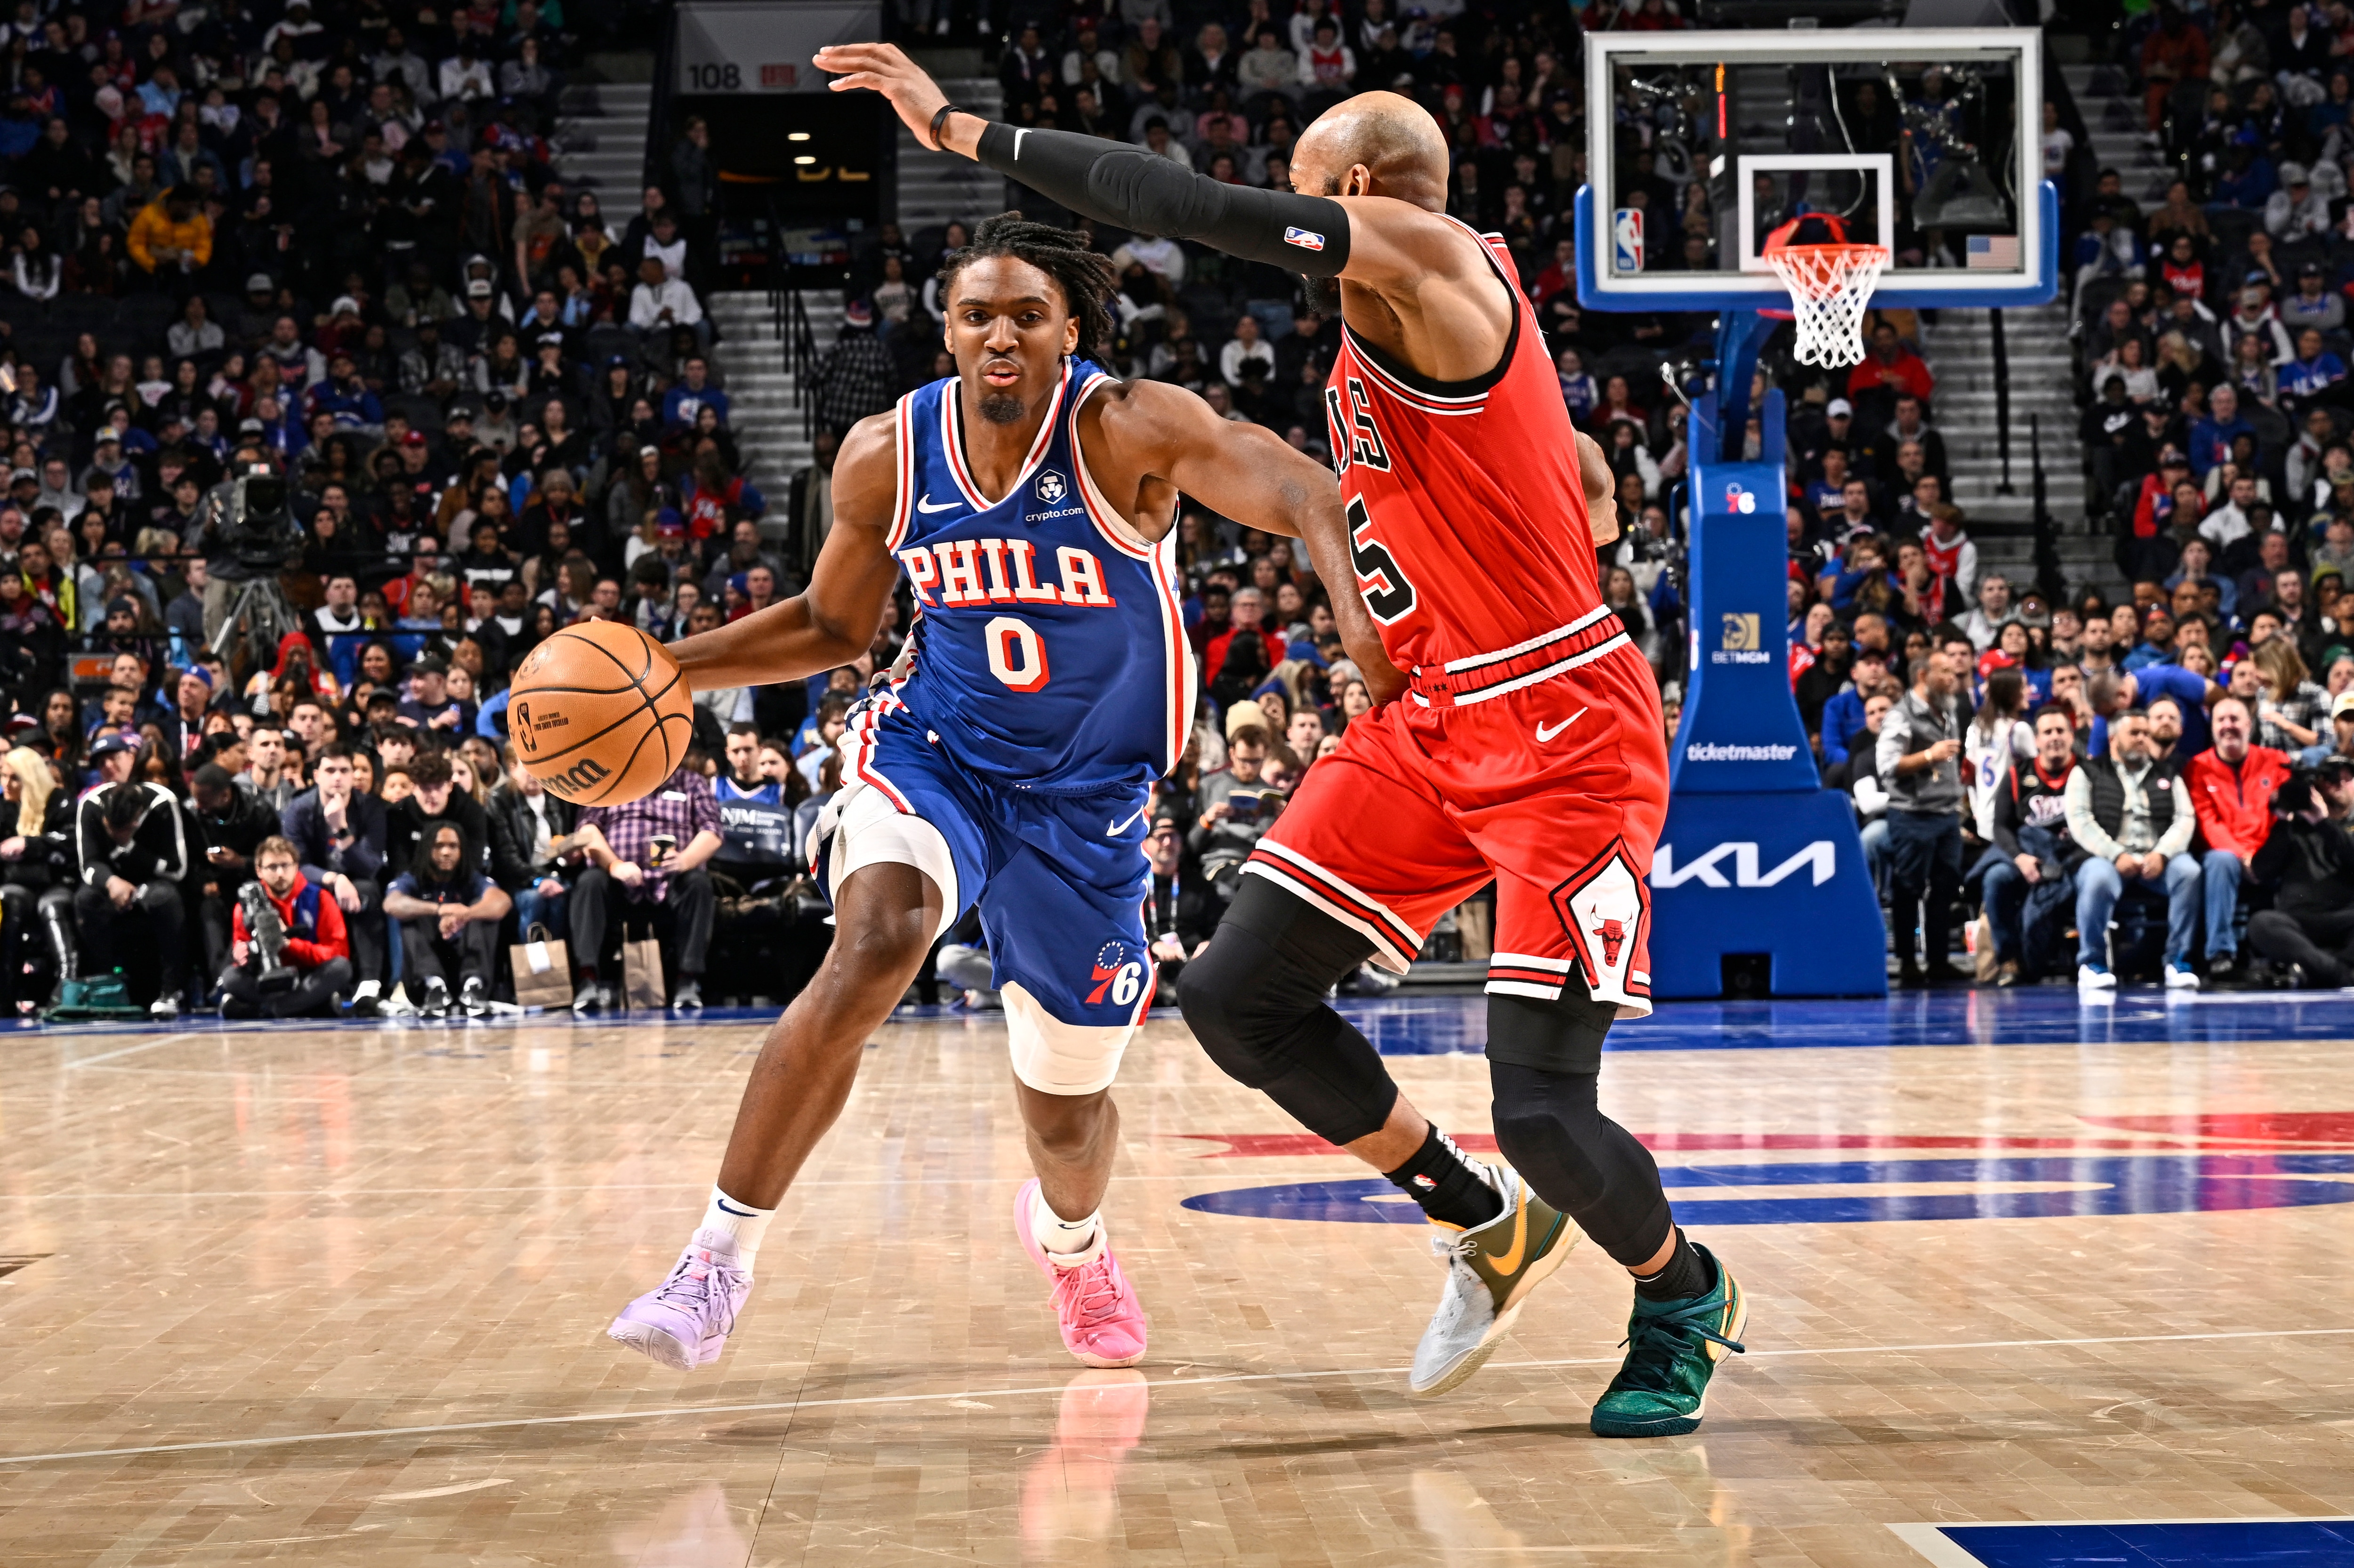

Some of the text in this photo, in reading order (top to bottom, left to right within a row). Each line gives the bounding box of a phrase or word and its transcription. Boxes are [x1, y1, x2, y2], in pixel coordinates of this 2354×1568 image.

[689, 62, 741, 90] 108
[1025, 507, 1084, 522] crypto.com
[1726, 492, 1756, 514] 76
[1345, 491, 1417, 627] 5
[897, 538, 1117, 608] PHILA
[984, 616, 1050, 692] 0
[1712, 651, 1770, 664] BETMGM
[541, 721, 552, 731] GAME
[552, 717, 569, 728] OFFICIAL
[1686, 742, 1798, 761] ticketmaster
[1983, 756, 1996, 788] 6
[720, 807, 757, 827] NJM
[1650, 841, 1836, 888] KIA
[1085, 961, 1141, 1006] 76
